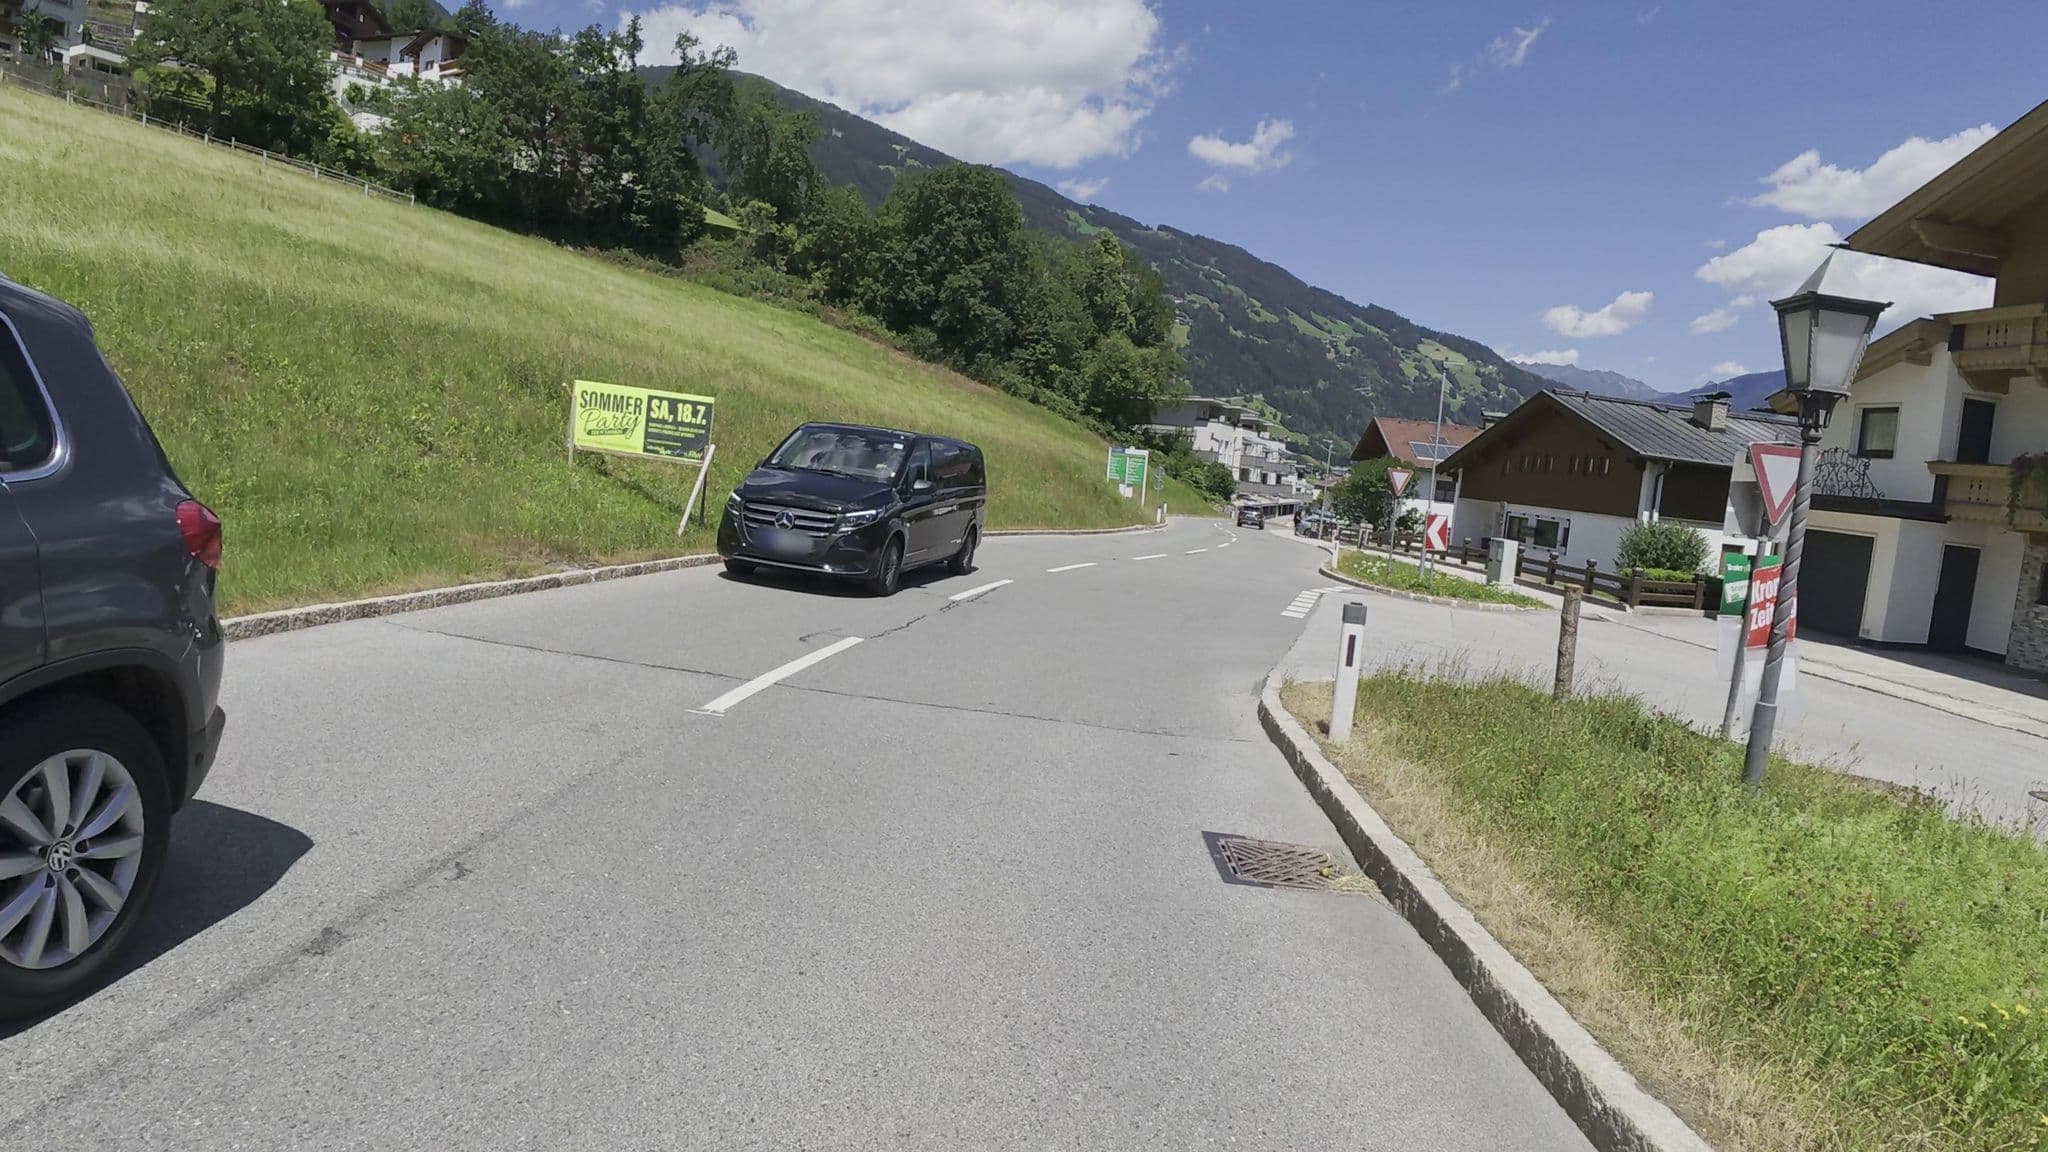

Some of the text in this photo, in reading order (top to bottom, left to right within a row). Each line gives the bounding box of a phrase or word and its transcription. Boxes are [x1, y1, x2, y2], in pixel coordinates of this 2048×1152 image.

[580, 390, 643, 415] SOMMER
[650, 398, 707, 425] SA, 18.7.
[580, 408, 640, 439] Party
[1751, 577, 1780, 605] Kron
